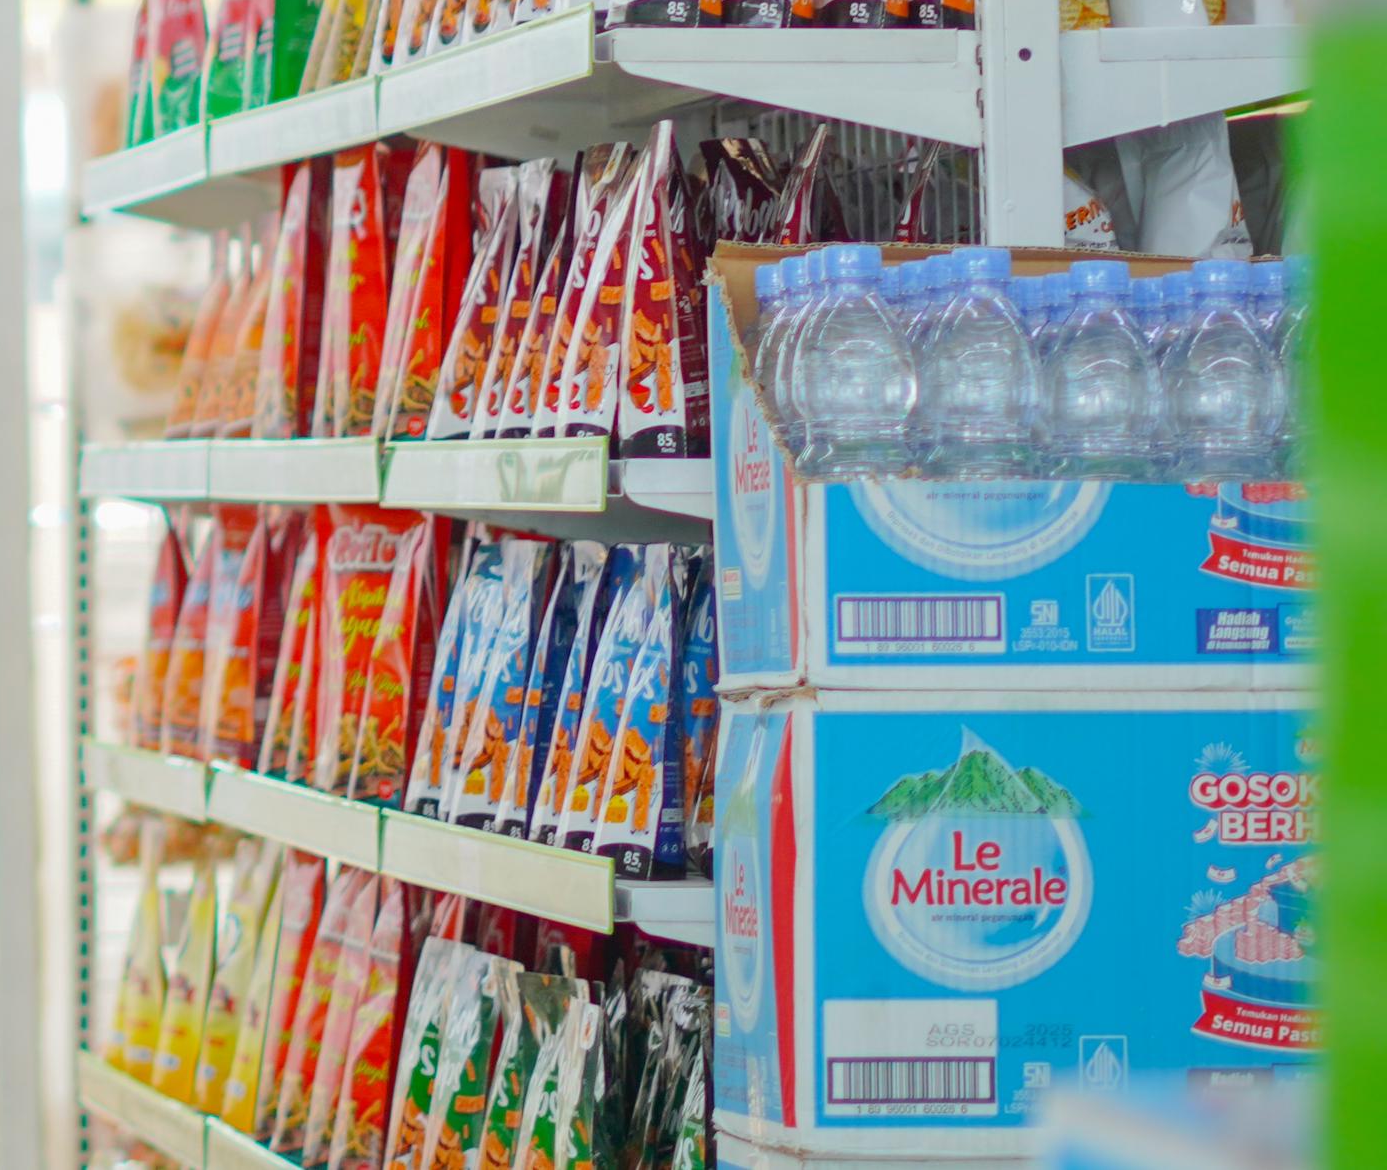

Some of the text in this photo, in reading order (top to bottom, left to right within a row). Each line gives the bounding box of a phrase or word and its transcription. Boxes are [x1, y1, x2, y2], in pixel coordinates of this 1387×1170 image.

[745, 409, 759, 453] Le
[735, 450, 771, 494] Minerale
[943, 491, 980, 500] mineral
[1218, 555, 1315, 583] Semua Pas
[1242, 548, 1284, 563] Temukan
[1030, 599, 1059, 627] SNI
[1217, 611, 1260, 626] Hadiah
[1209, 626, 1269, 641] Langsung
[953, 830, 1001, 872] Le
[733, 851, 745, 895] Le
[891, 867, 1067, 906] Minerale
[725, 892, 758, 938] Minerale
[1211, 1014, 1273, 1039] Semua
[1236, 1006, 1278, 1022] Temukan
[928, 1023, 976, 1037] AGS
